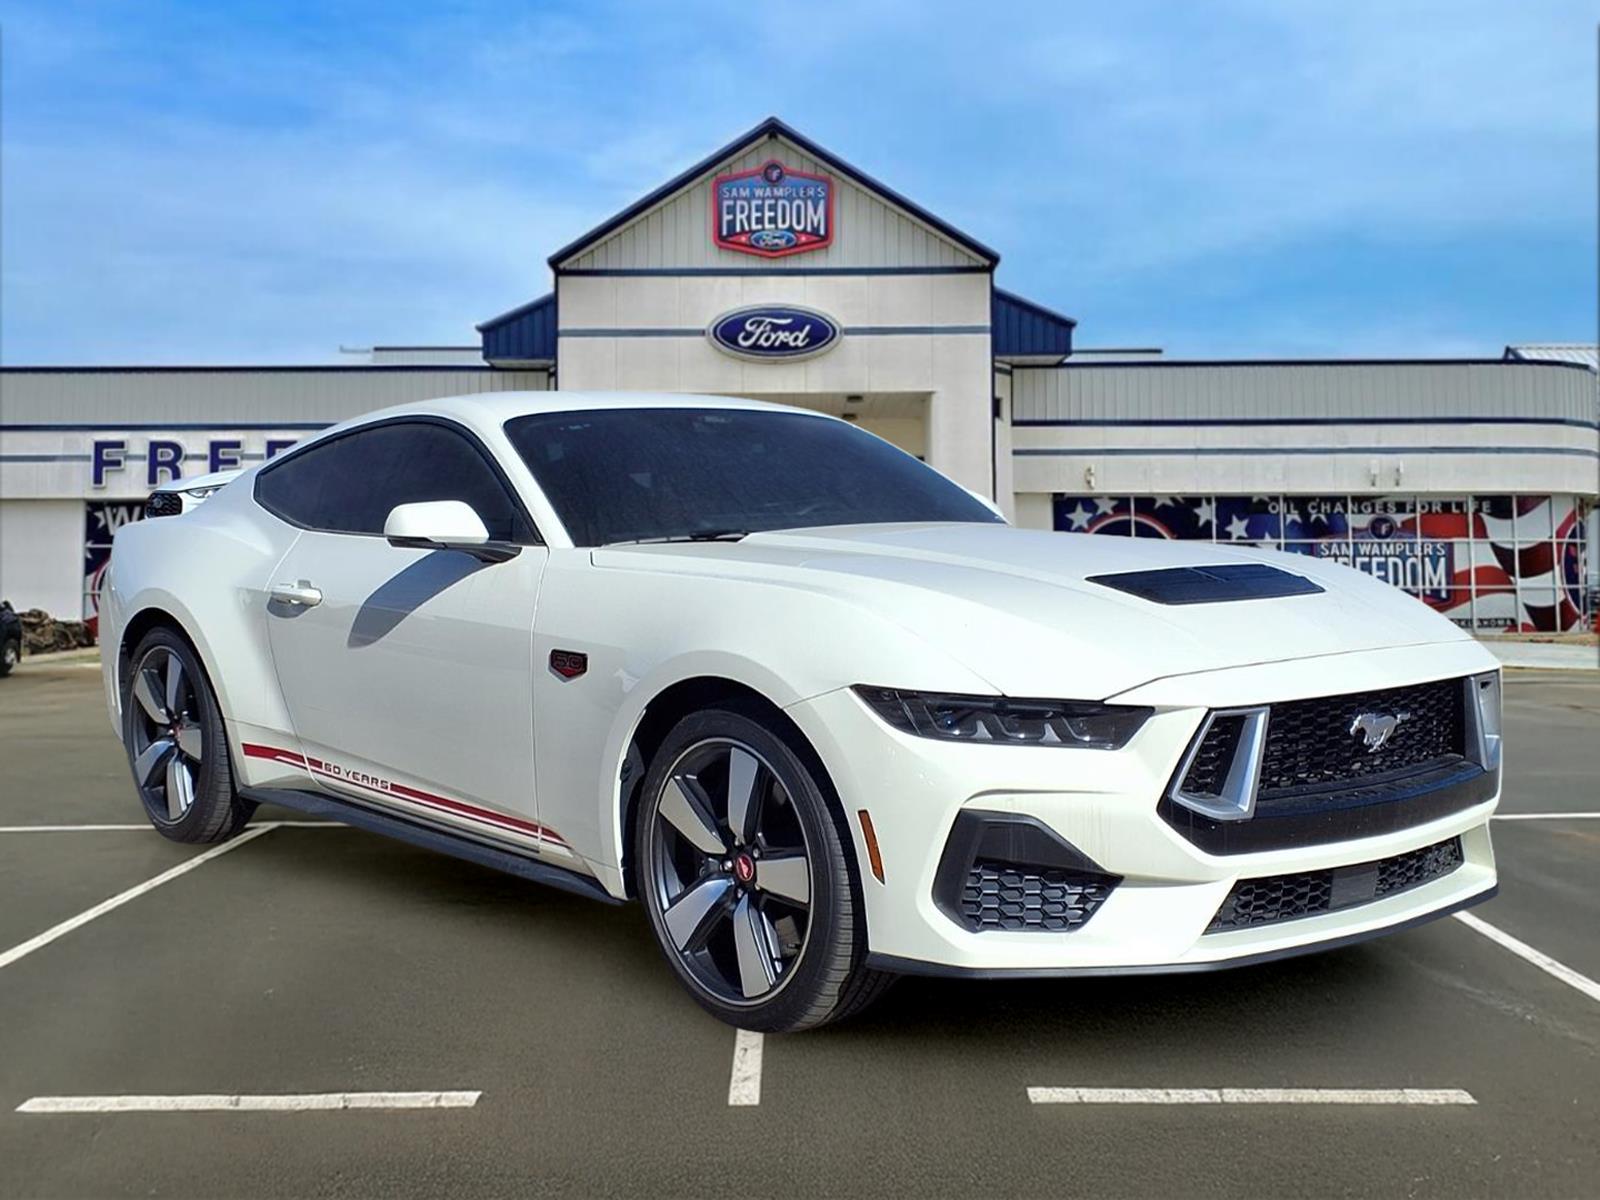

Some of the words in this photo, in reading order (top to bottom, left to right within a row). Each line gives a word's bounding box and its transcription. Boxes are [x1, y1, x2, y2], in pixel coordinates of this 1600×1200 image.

[723, 187, 750, 198] SAM
[722, 199, 825, 236] FREEDOM
[759, 232, 786, 247] Ford
[737, 316, 811, 347] Ford
[1268, 501, 1299, 514] OIL
[1307, 501, 1397, 514] CHANGES
[1405, 501, 1443, 514] FOR
[1452, 501, 1491, 514] LIFE
[324, 762, 341, 775] 60
[344, 768, 388, 790] YEARS
